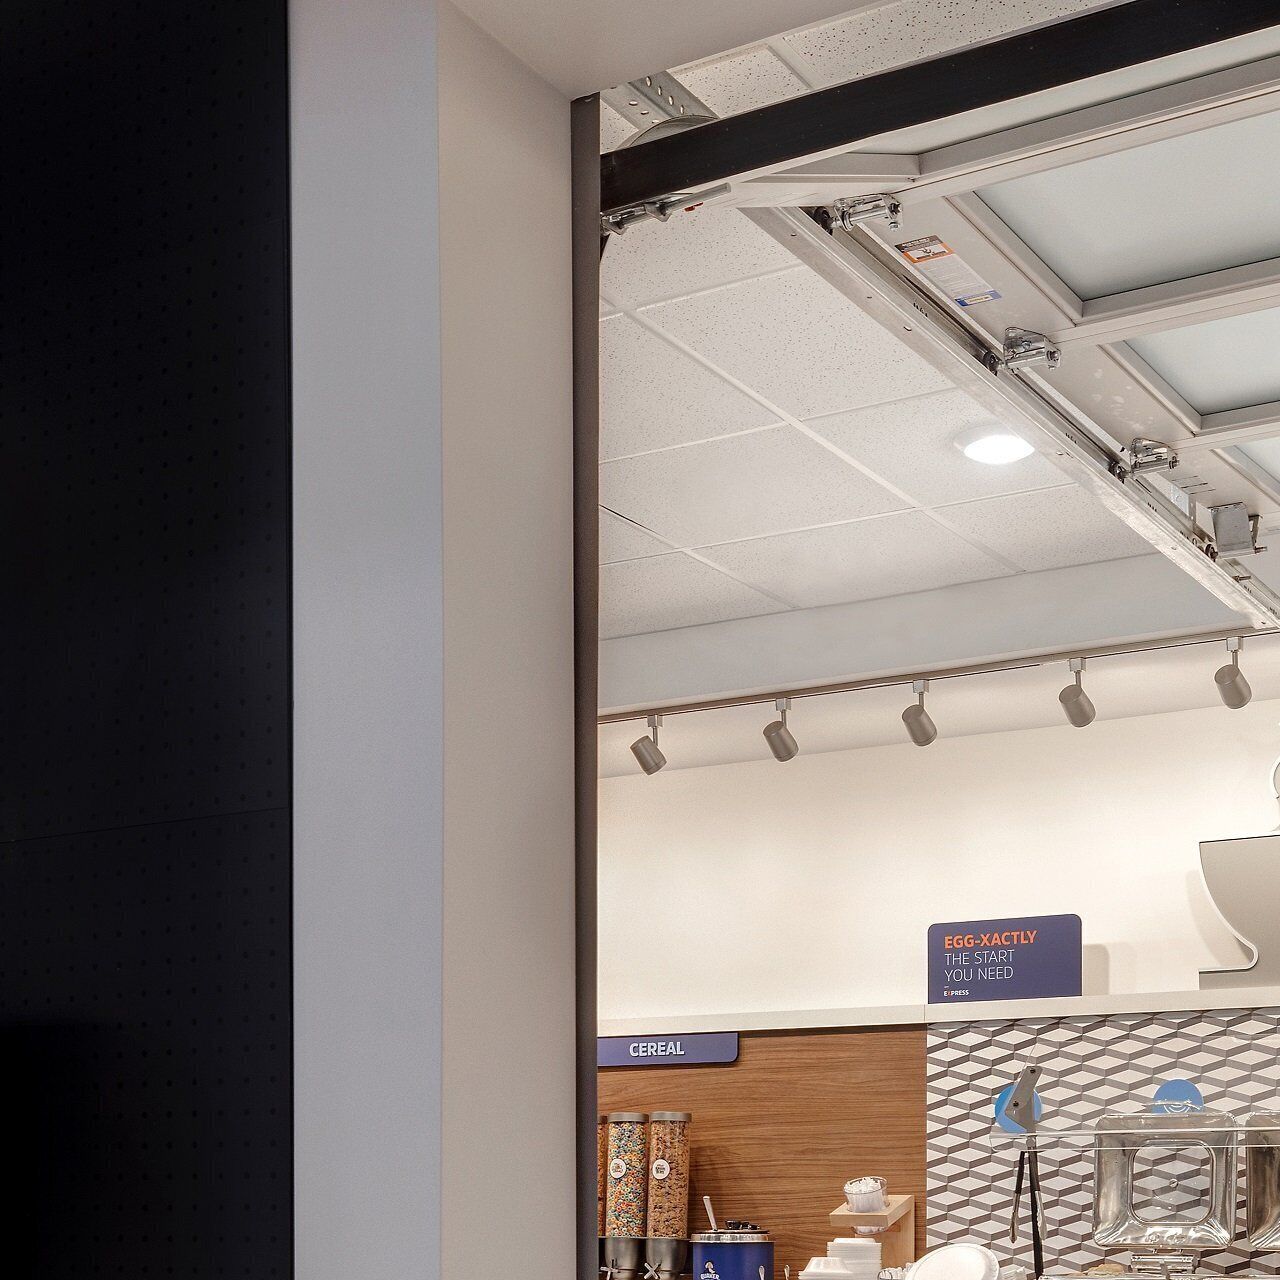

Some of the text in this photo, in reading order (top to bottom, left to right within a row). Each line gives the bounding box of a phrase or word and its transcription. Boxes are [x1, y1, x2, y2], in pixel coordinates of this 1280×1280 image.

[944, 930, 1038, 949] EGG-XACTLY
[944, 949, 1015, 966] THE START
[944, 966, 1014, 982] YOU NEED
[943, 989, 970, 997] EXPRESS
[629, 1041, 685, 1057] CEREAL
